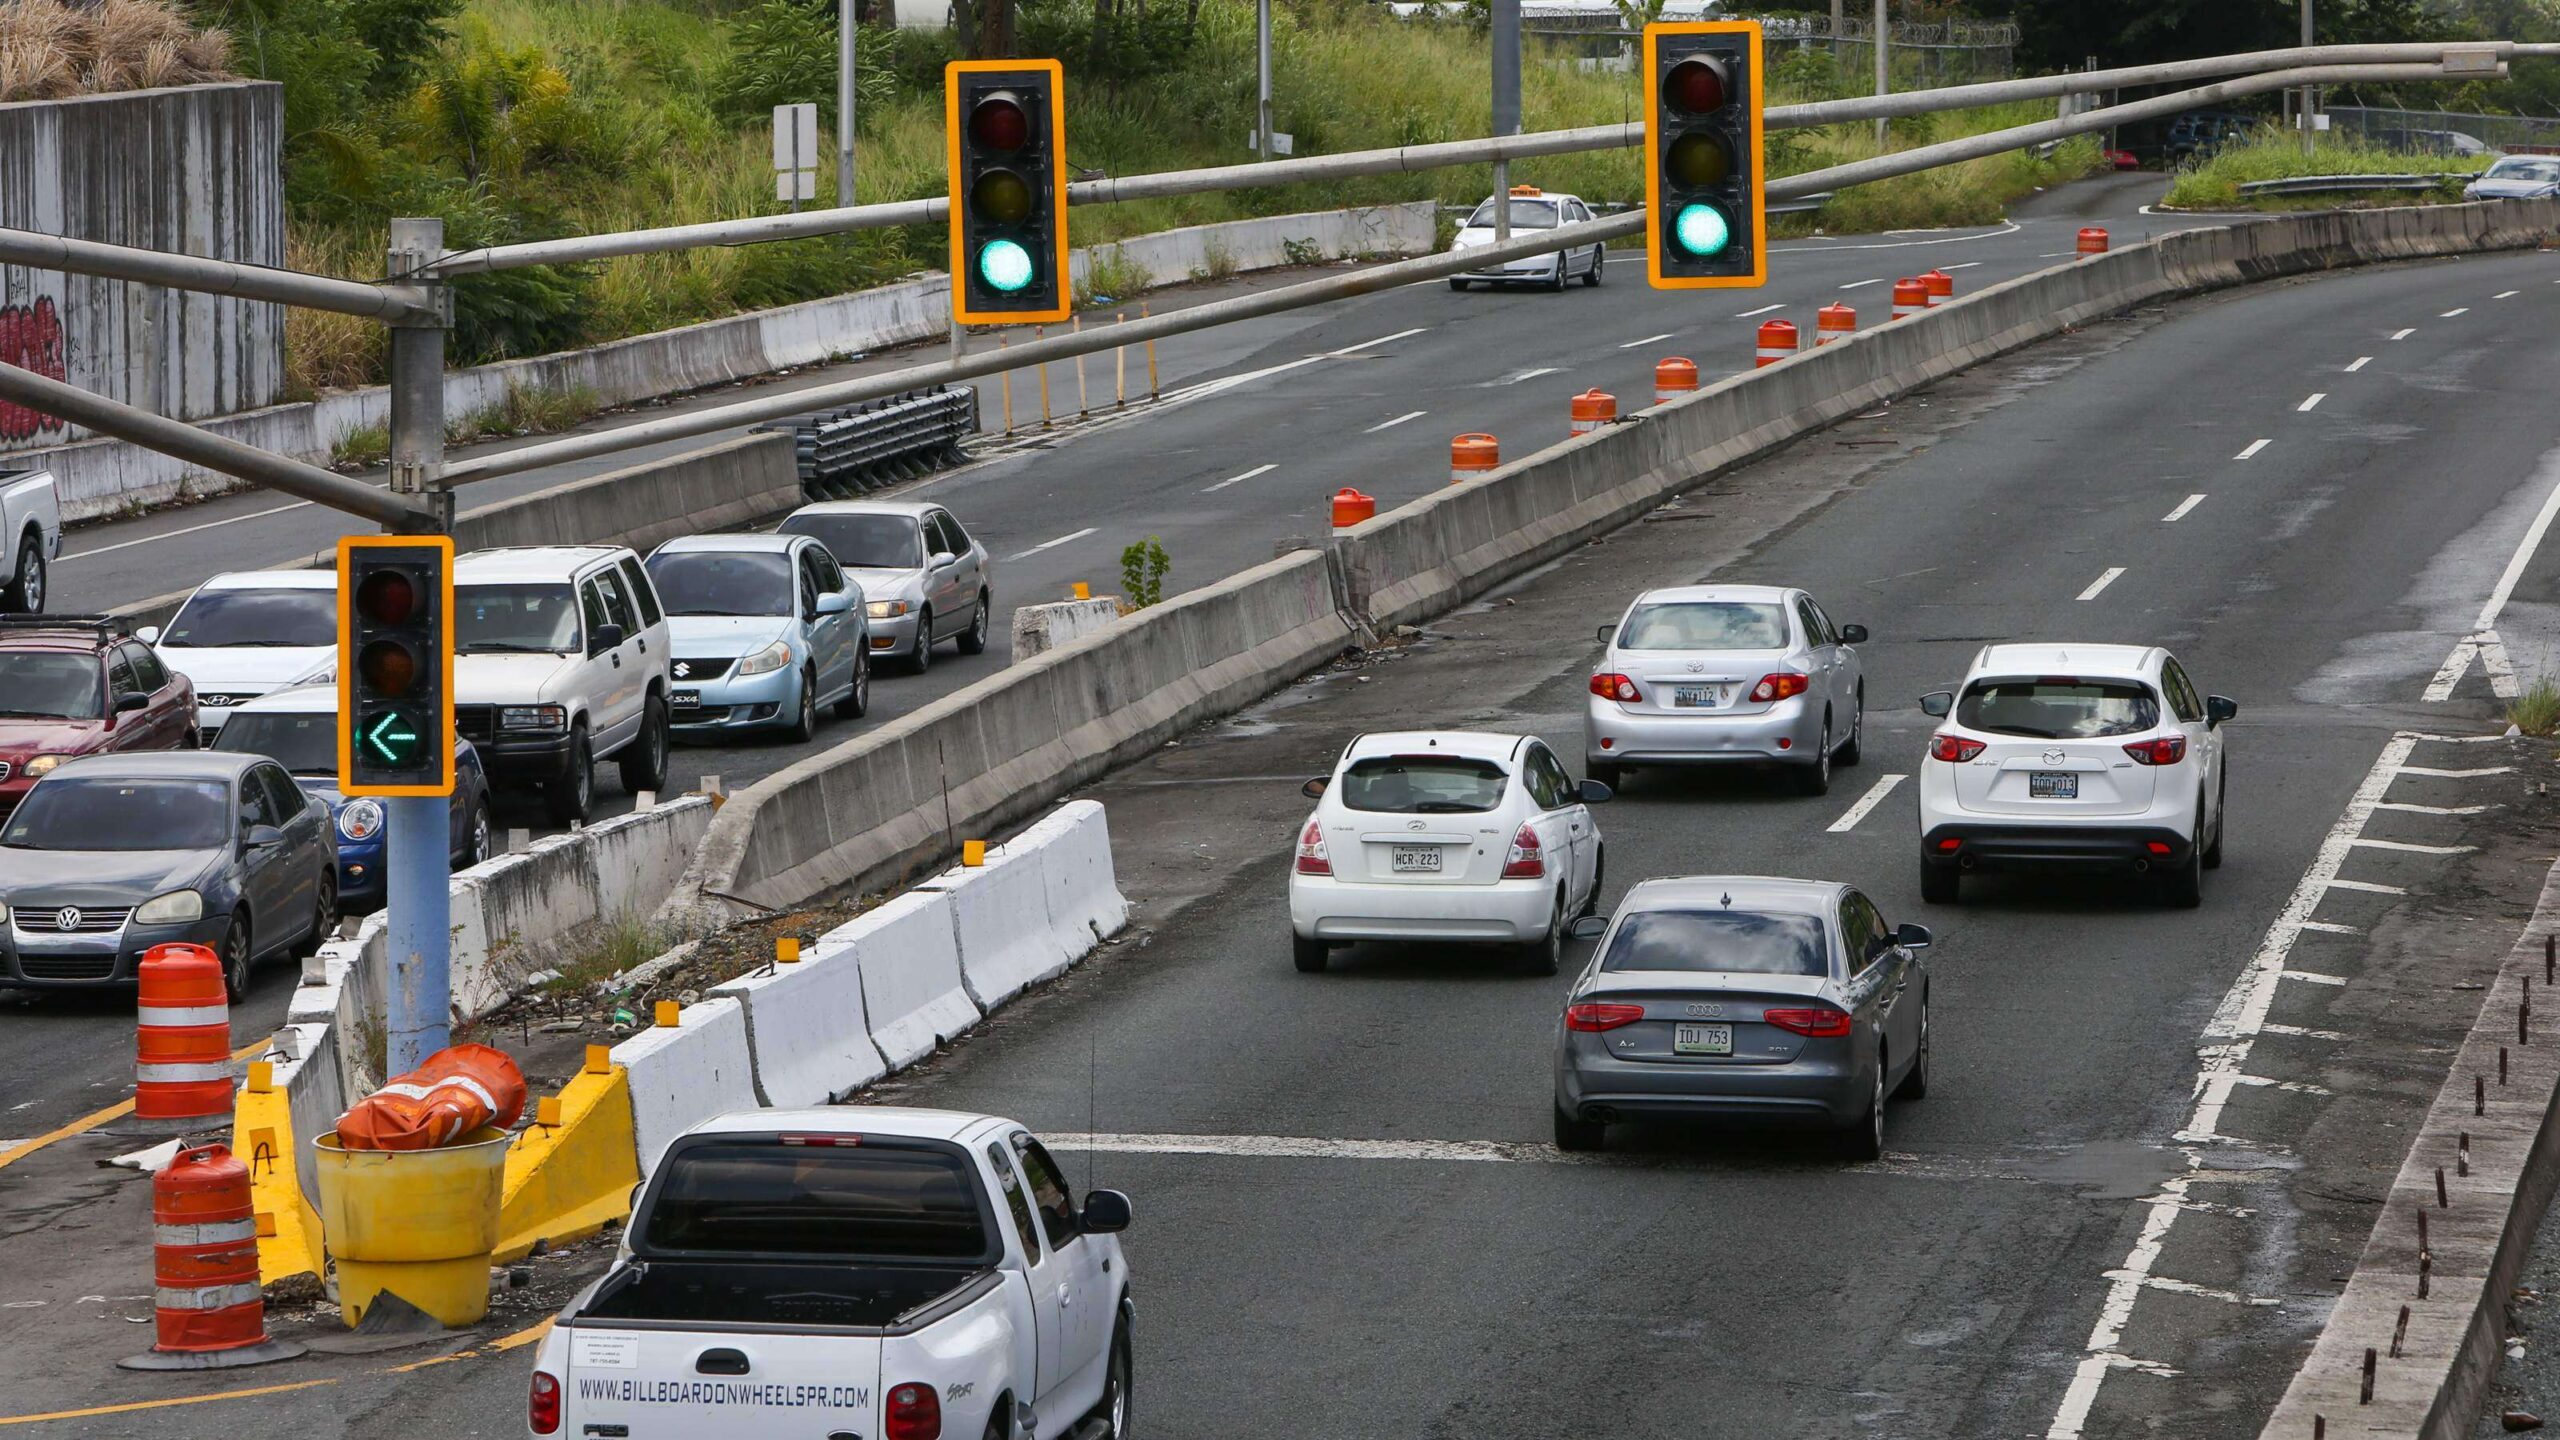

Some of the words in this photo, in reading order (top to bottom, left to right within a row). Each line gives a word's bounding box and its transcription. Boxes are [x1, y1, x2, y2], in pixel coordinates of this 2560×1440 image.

[673, 695, 698, 703] SX4
[1395, 853, 1414, 866] HCR
[1420, 853, 1439, 866] 223
[1707, 1030, 1728, 1045] 753
[579, 1377, 868, 1409] WWW.BILLBOARDONWHEELSPR.COM
